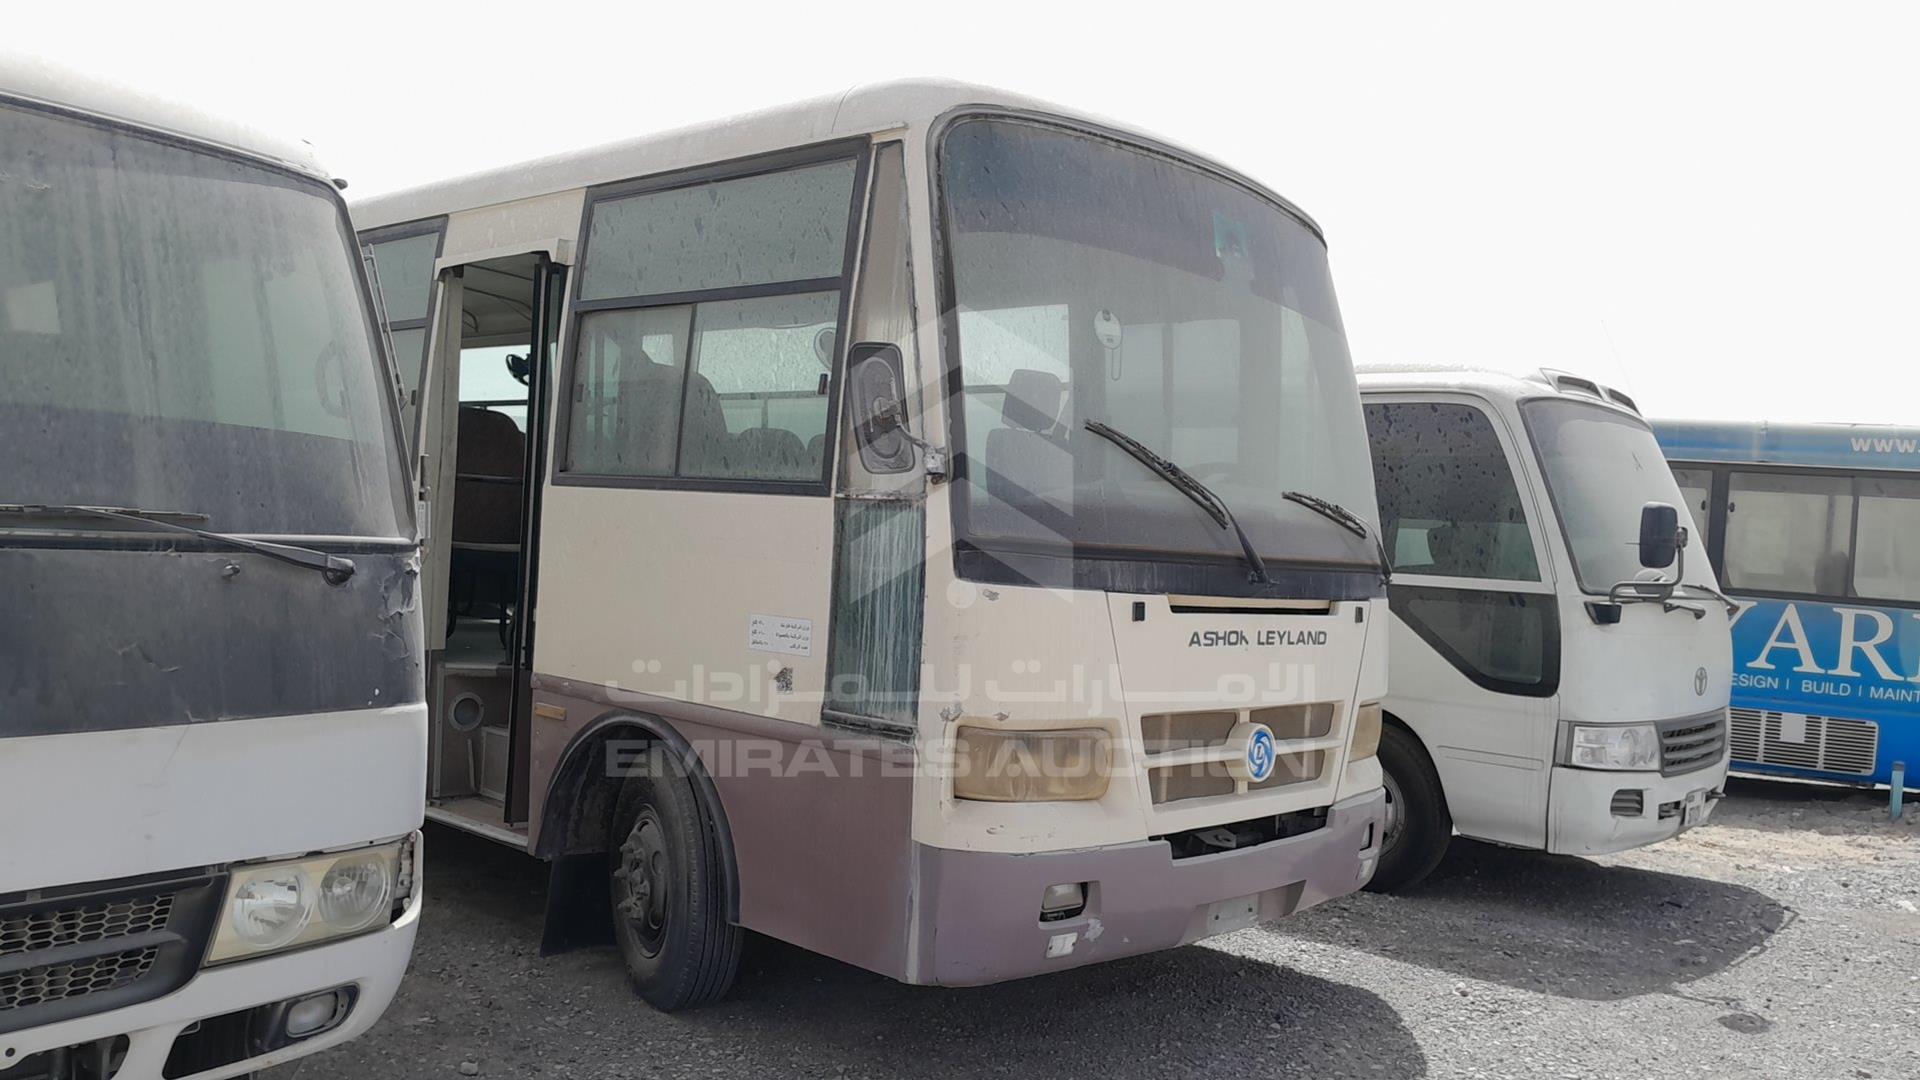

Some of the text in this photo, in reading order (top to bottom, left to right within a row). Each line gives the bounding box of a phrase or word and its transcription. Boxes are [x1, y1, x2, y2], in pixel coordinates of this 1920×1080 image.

[1256, 629, 1328, 646] LEYLAND
[1729, 600, 1920, 684] AR
[1801, 679, 1852, 697] BUILD
